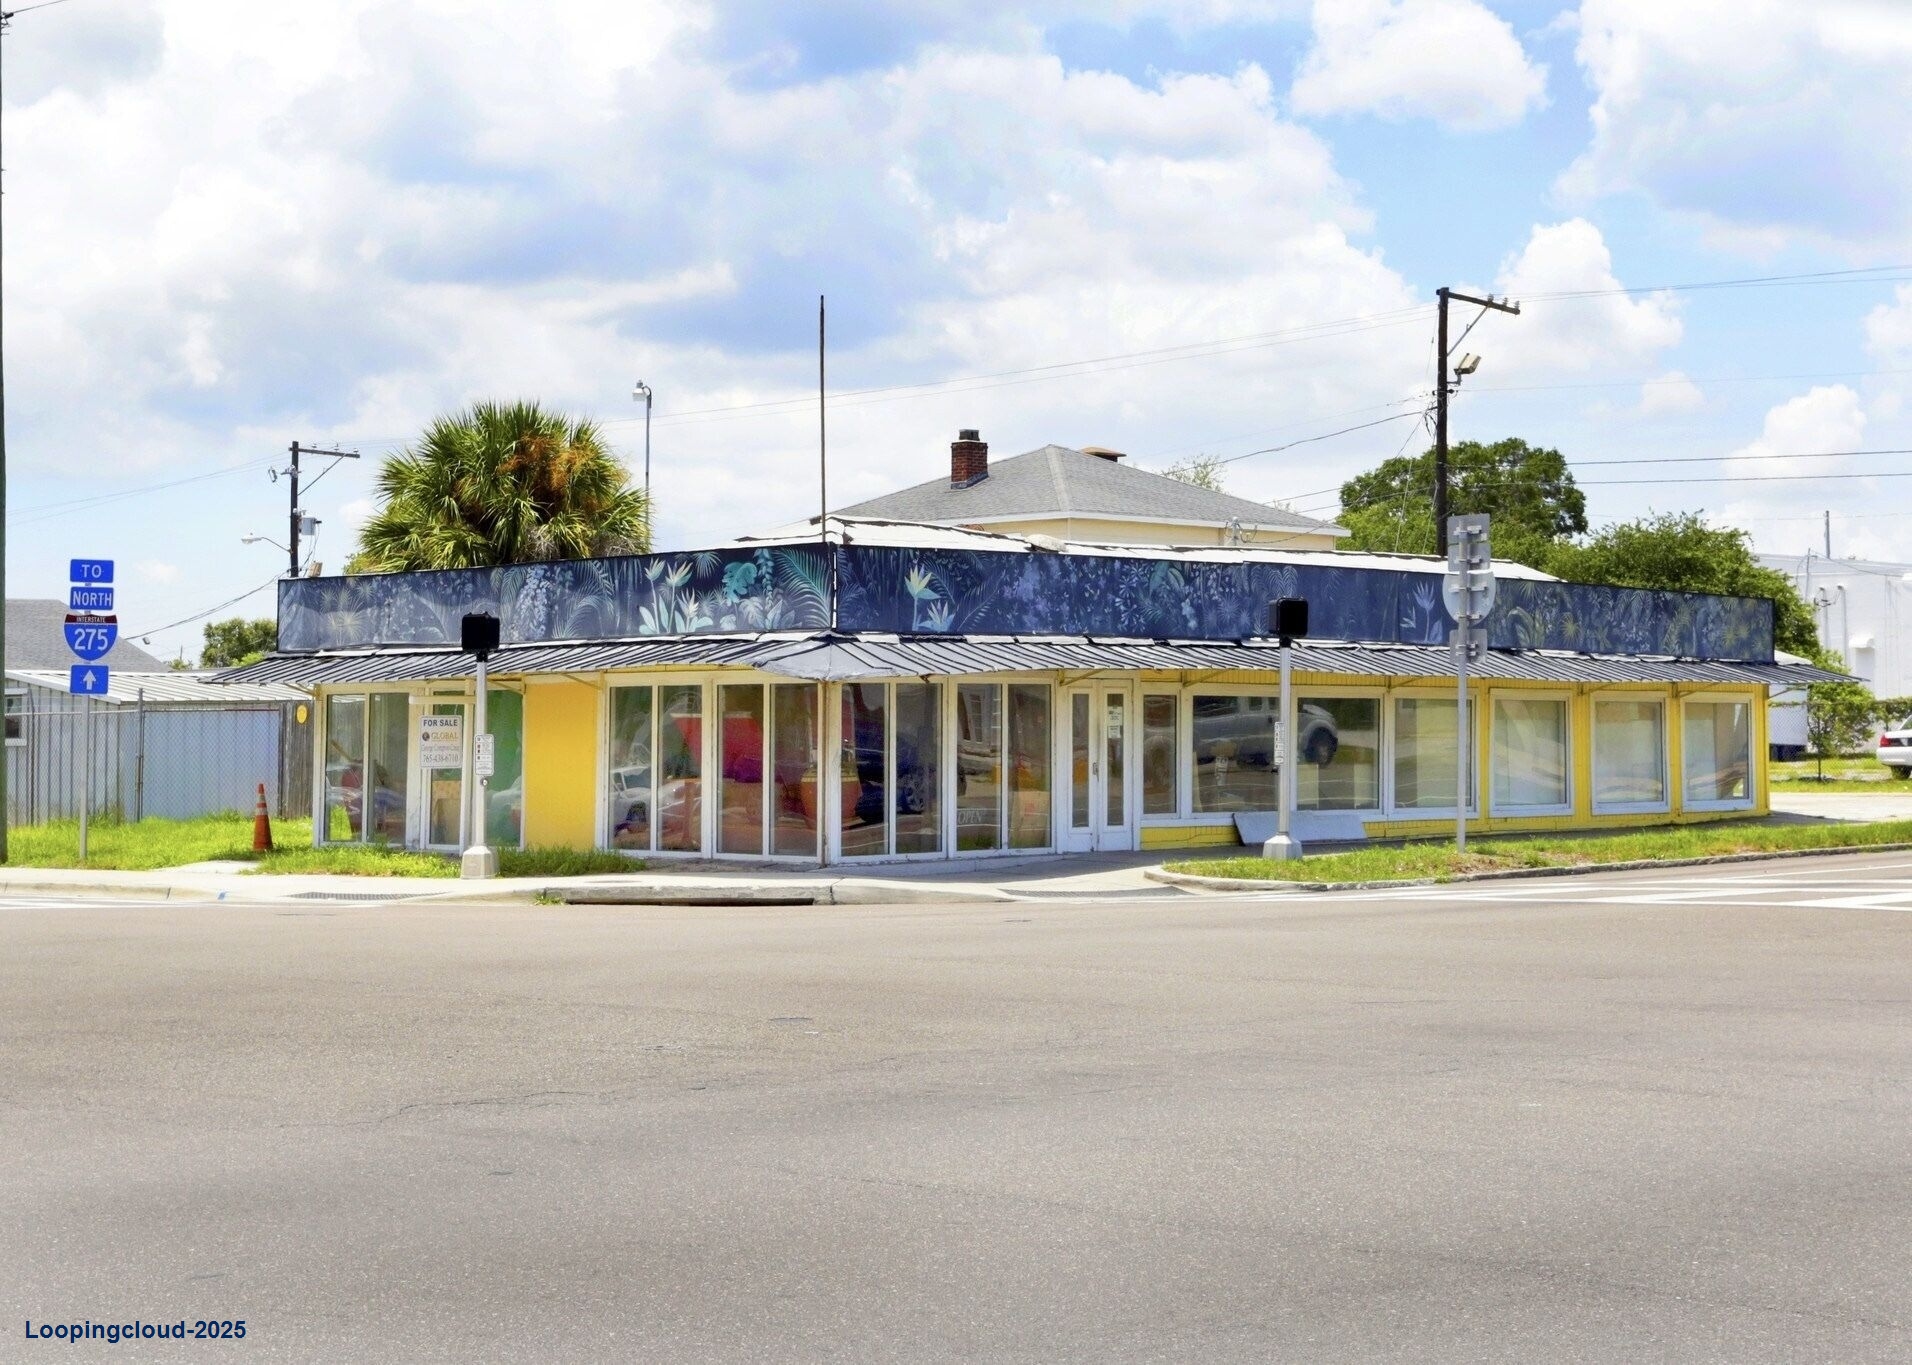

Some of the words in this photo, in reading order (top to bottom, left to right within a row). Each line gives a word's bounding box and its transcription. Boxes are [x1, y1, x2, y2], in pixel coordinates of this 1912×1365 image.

[81, 564, 102, 579] TO
[72, 590, 113, 608] NORTH
[76, 616, 106, 624] INTERSTATE
[74, 628, 108, 651] 275
[423, 719, 438, 727] FOR
[439, 719, 458, 727] SALE
[431, 731, 459, 740] GLOBAL
